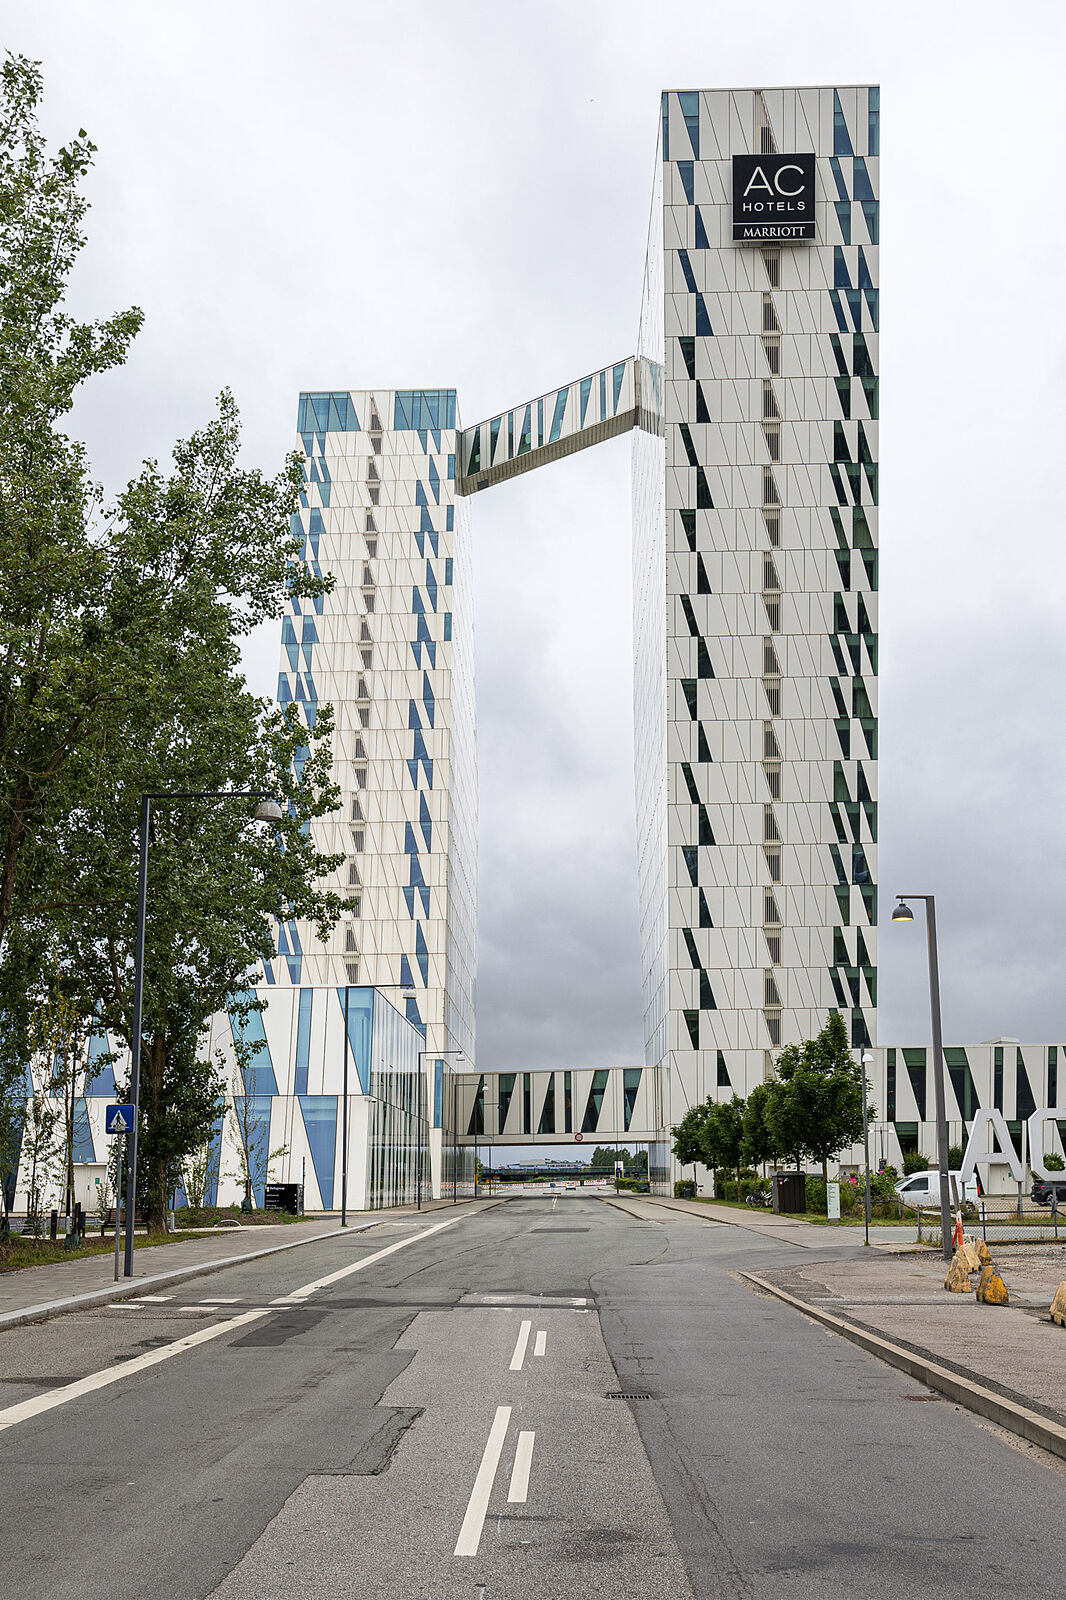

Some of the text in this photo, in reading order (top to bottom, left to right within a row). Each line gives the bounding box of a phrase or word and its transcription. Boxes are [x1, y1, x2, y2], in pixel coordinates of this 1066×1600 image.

[743, 164, 805, 197] AC
[742, 201, 806, 212] HOTELS
[743, 226, 806, 238] MARRIOTT
